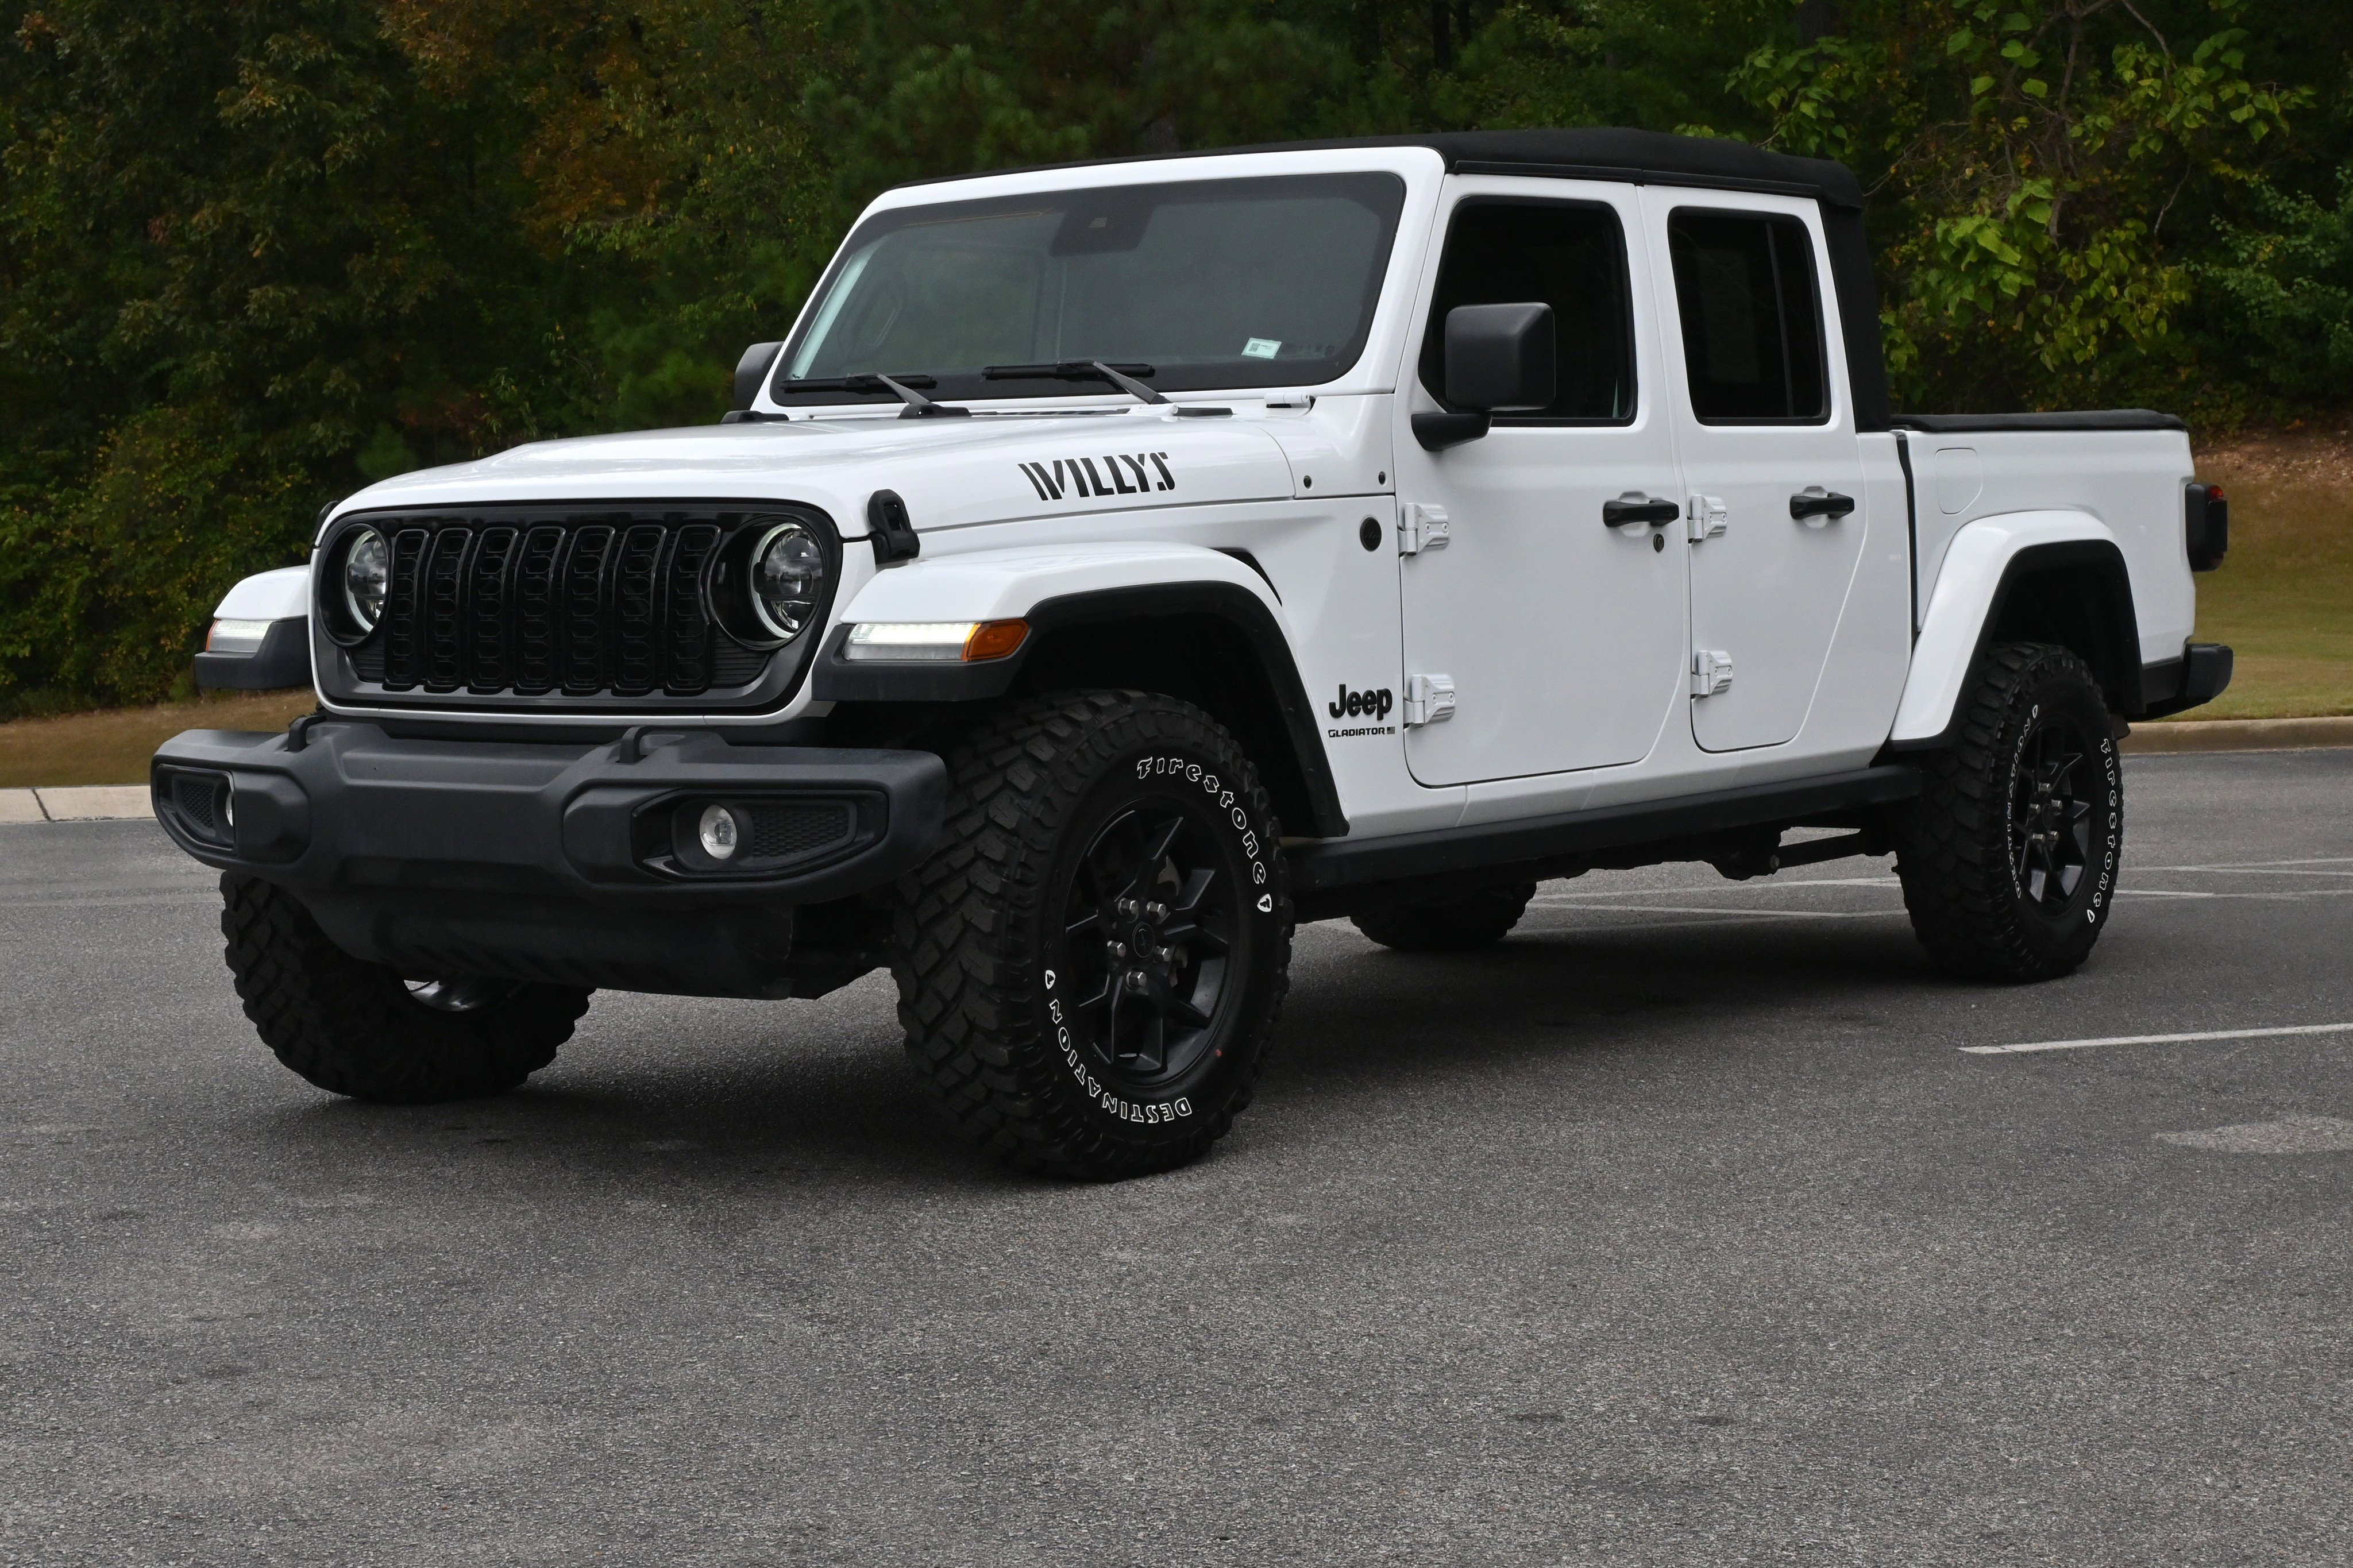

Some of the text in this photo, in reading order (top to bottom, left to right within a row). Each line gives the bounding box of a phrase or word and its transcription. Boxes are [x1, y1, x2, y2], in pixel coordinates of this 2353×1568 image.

[1017, 452, 1175, 501] WILLYS
[1329, 683, 1392, 721] Jeep
[1328, 727, 1385, 737] GLADIATOR
[1136, 756, 1267, 885] Firestone
[1048, 998, 1193, 1124] DESTINATION
